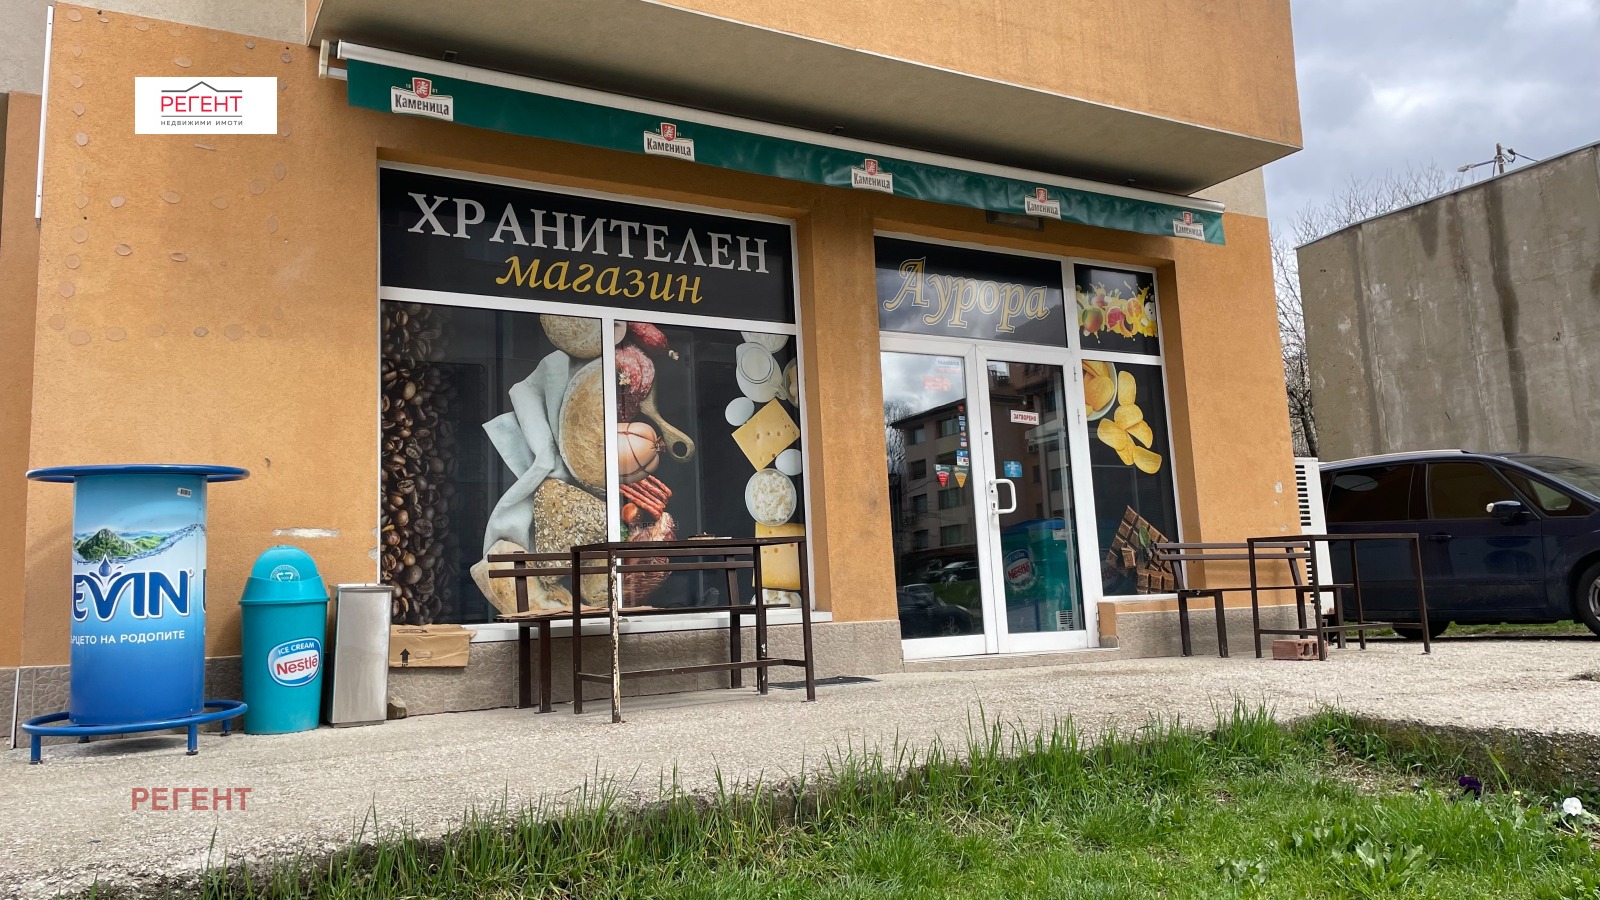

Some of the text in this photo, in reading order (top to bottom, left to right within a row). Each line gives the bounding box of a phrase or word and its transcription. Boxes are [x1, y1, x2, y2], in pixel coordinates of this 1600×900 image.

[394, 93, 450, 116] Каменица
[647, 137, 692, 156] Каменица
[853, 172, 891, 189] Каменица
[407, 191, 769, 274] ХРАНИТЕЛЕН
[496, 255, 703, 304] магазин
[883, 256, 1050, 333] Аурора
[1013, 413, 1037, 422] ЗАТВОРЕНО
[101, 634, 116, 644] НА
[120, 630, 185, 644] РОДОПИТЕ
[278, 641, 315, 655] ICE CREAM
